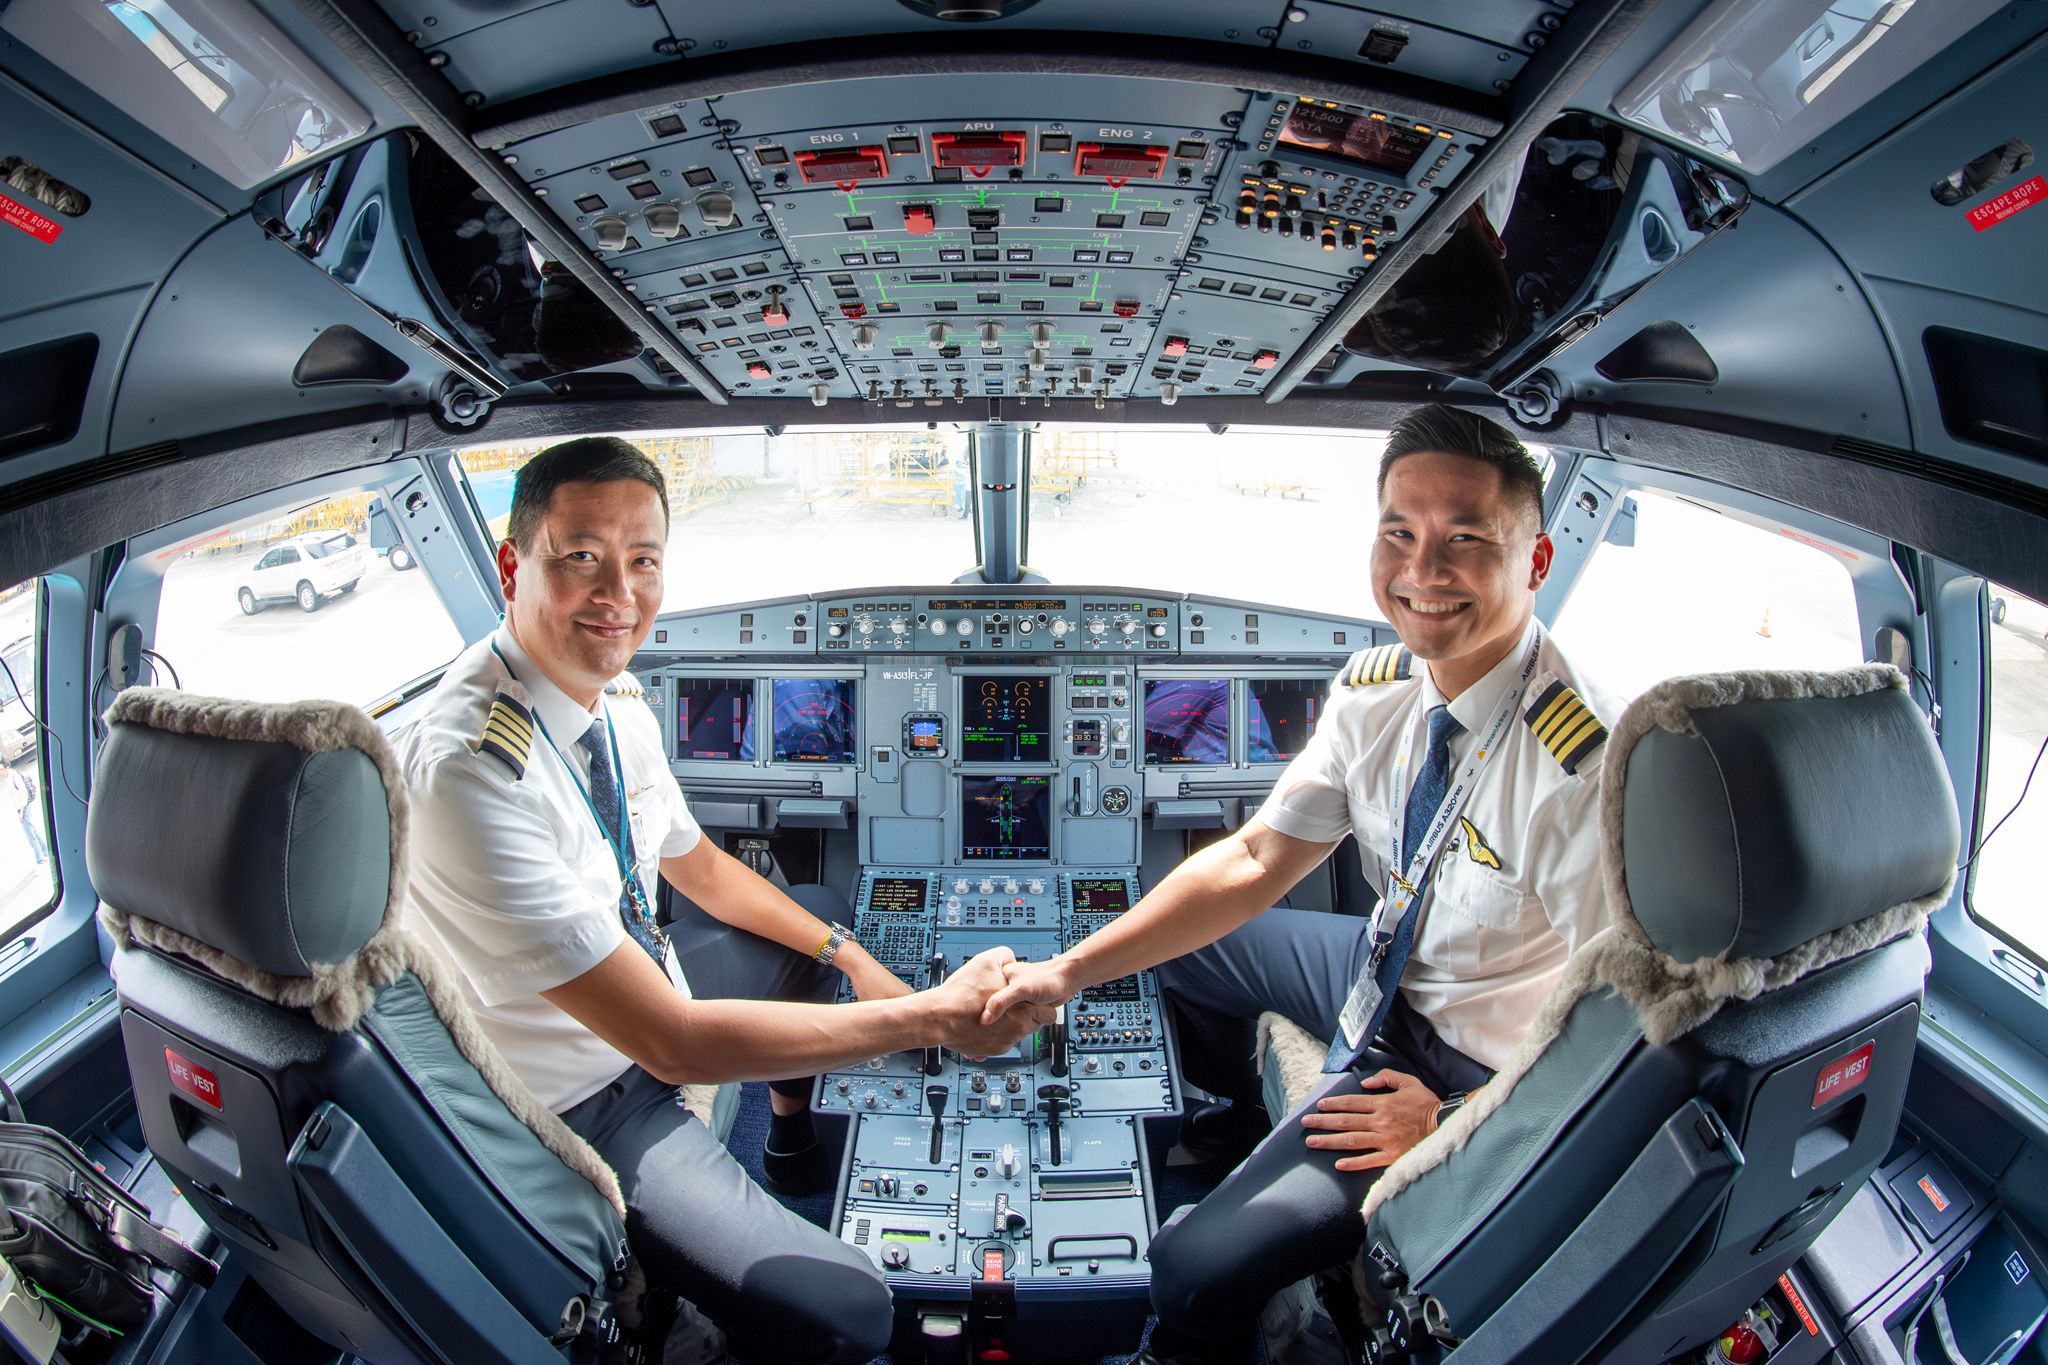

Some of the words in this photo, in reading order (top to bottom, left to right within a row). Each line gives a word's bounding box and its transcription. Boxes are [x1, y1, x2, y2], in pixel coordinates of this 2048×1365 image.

[1288, 120, 1322, 133] DATA
[1295, 107, 1343, 124] 121.500
[810, 133, 844, 144] ENG
[852, 132, 859, 140] 1
[1099, 128, 1133, 138] ENG
[1143, 131, 1152, 139] 2
[1973, 195, 2013, 221] ESCAPE
[2013, 181, 2040, 201] ROPE
[0, 196, 30, 220] SCAPE
[30, 216, 55, 234] ROPE
[1521, 646, 1539, 682] AIRBUS
[1482, 709, 1509, 751] VietnamAirlines
[1426, 821, 1445, 851] AIRBUS
[1443, 784, 1463, 823] A320neo
[170, 1060, 189, 1081] LIFE
[191, 1071, 215, 1096] VEST
[1818, 1072, 1841, 1094] LIFE
[1845, 1055, 1868, 1079] VEST
[998, 1194, 1006, 1213] PARK
[996, 1214, 1005, 1229] BRK
[1787, 1288, 1800, 1303] FIRE
